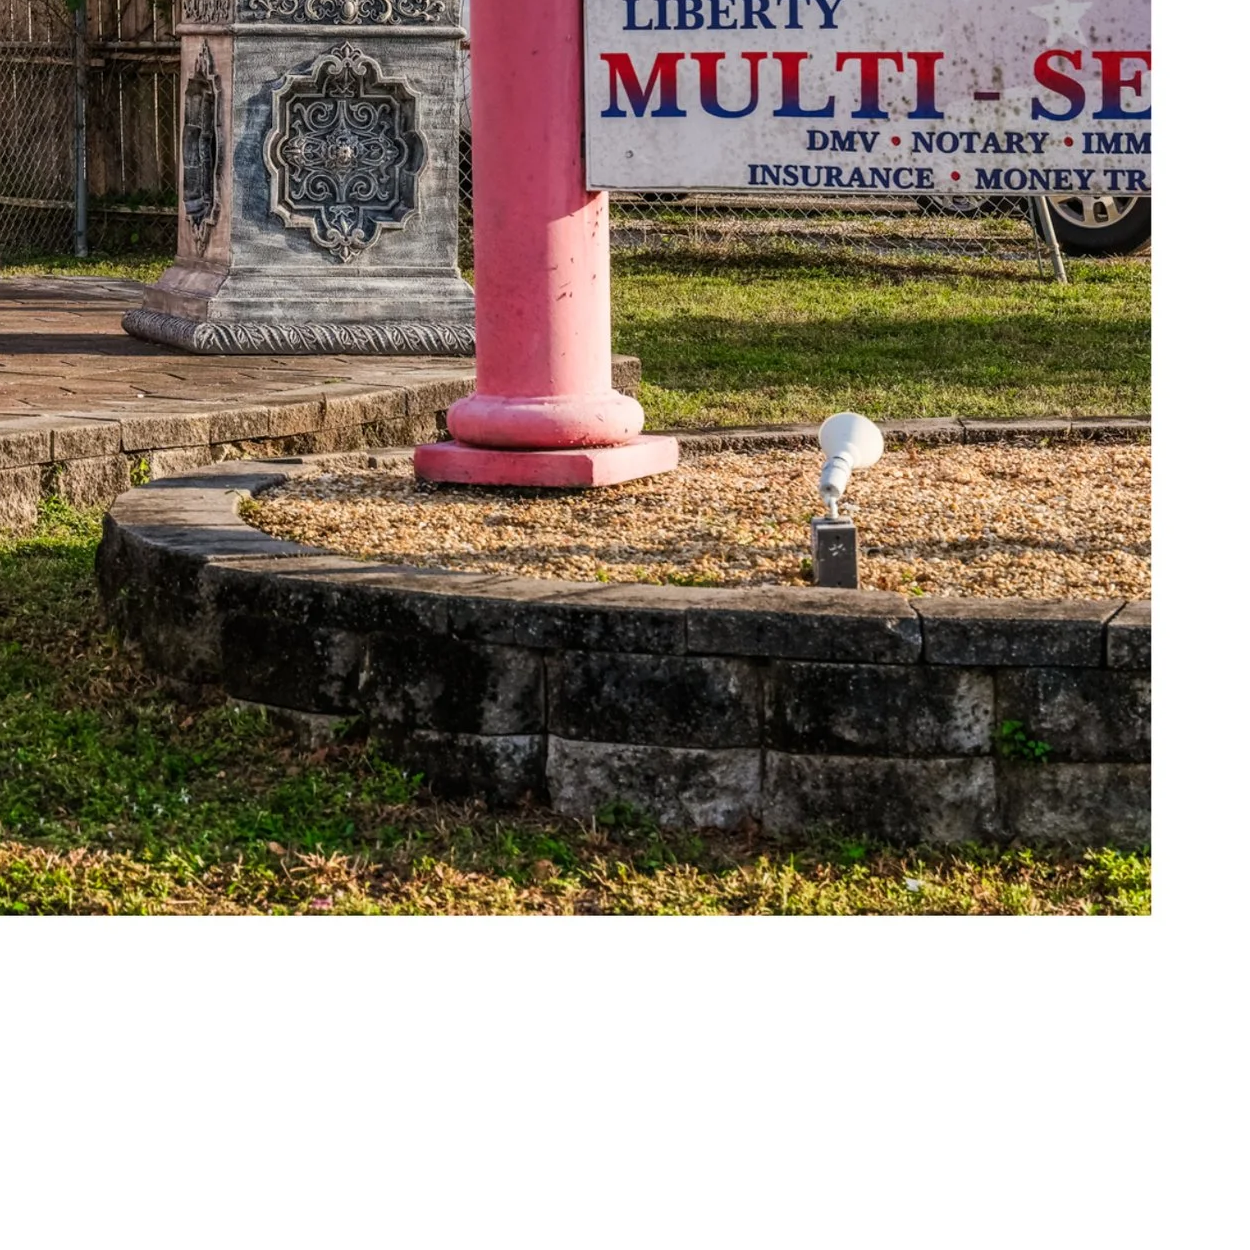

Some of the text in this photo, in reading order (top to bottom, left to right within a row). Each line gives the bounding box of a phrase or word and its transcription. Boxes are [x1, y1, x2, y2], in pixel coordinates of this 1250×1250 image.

[600, 51, 945, 120] MULTI
[807, 130, 880, 153] DMV
[912, 131, 1049, 154] NOTARY
[748, 164, 935, 189] INSURANCE
[975, 168, 1095, 191] MONEY
